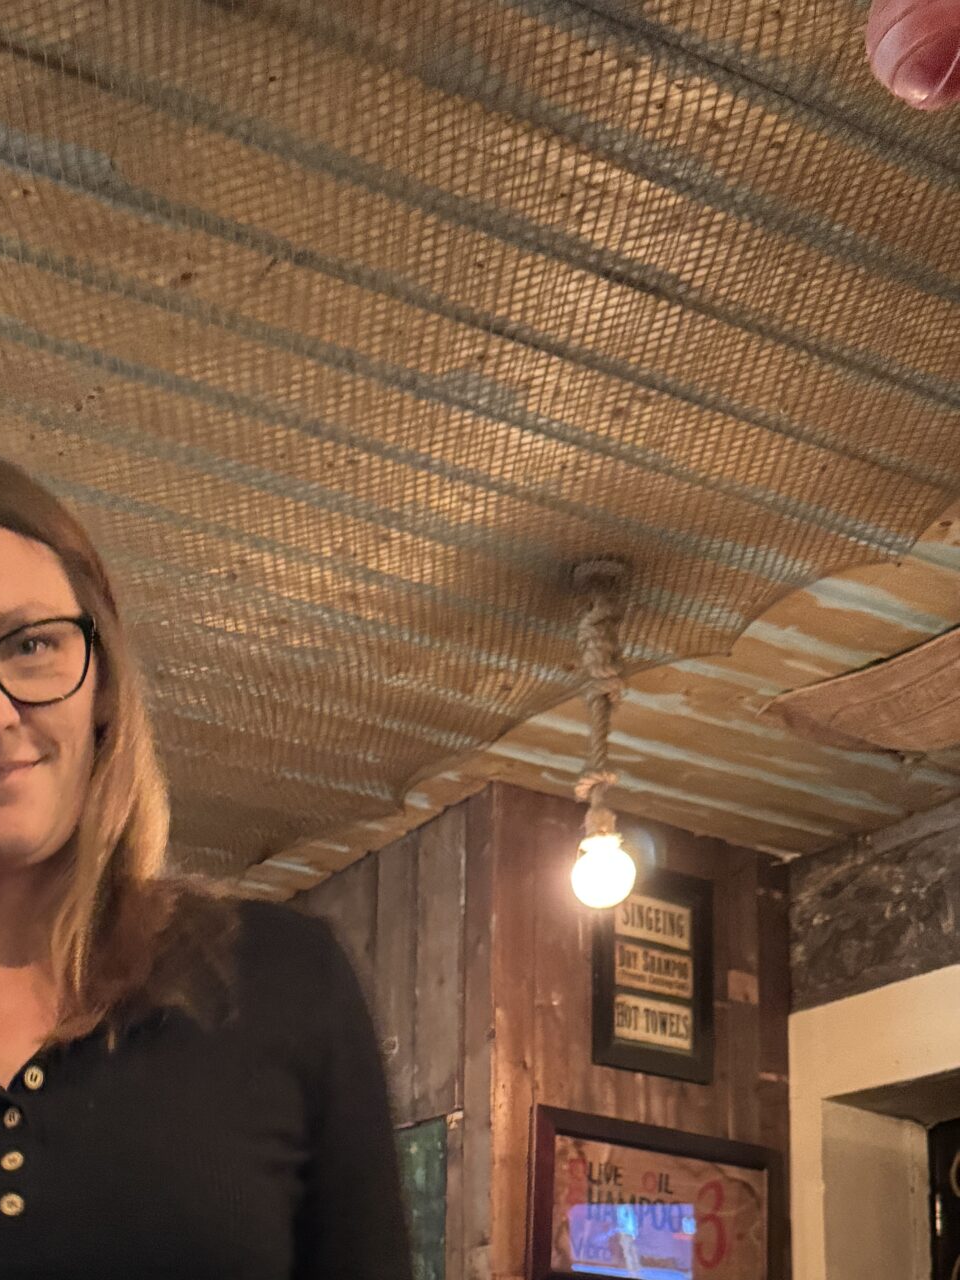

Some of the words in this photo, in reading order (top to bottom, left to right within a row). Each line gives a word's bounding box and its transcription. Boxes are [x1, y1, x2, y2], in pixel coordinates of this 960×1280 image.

[622, 902, 685, 939] SINGEING
[616, 1001, 639, 1031] HOT
[643, 1008, 689, 1040] TOWELS
